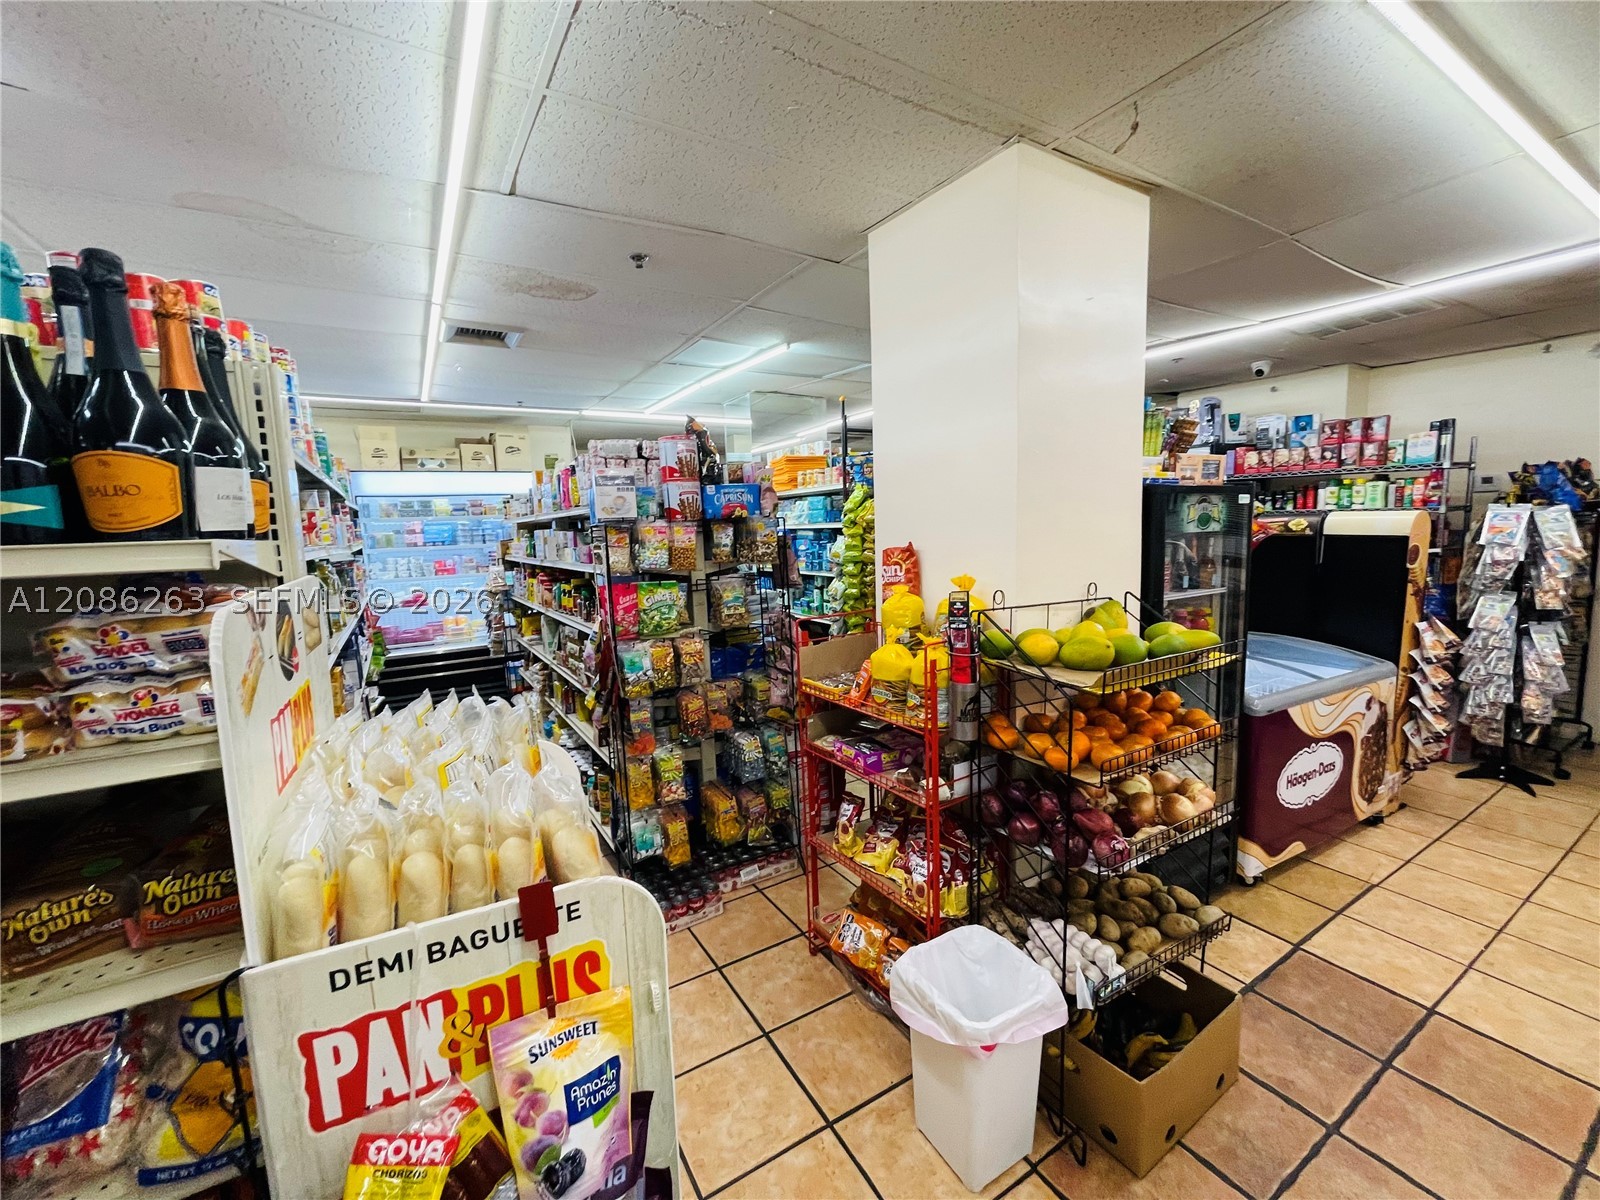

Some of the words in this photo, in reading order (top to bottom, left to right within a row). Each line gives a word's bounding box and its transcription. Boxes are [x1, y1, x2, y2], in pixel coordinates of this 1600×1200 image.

[114, 703, 180, 721] WONDER
[147, 719, 185, 733] Buns
[163, 885, 222, 915] Own
[196, 902, 238, 919] Whea
[29, 909, 91, 944] Own
[329, 949, 414, 993] DEMI
[426, 900, 582, 964] BAGUEE
[528, 1020, 598, 1064] SUNSWEET
[577, 1080, 617, 1112] Prunes
[368, 1138, 444, 1164] GOYA
